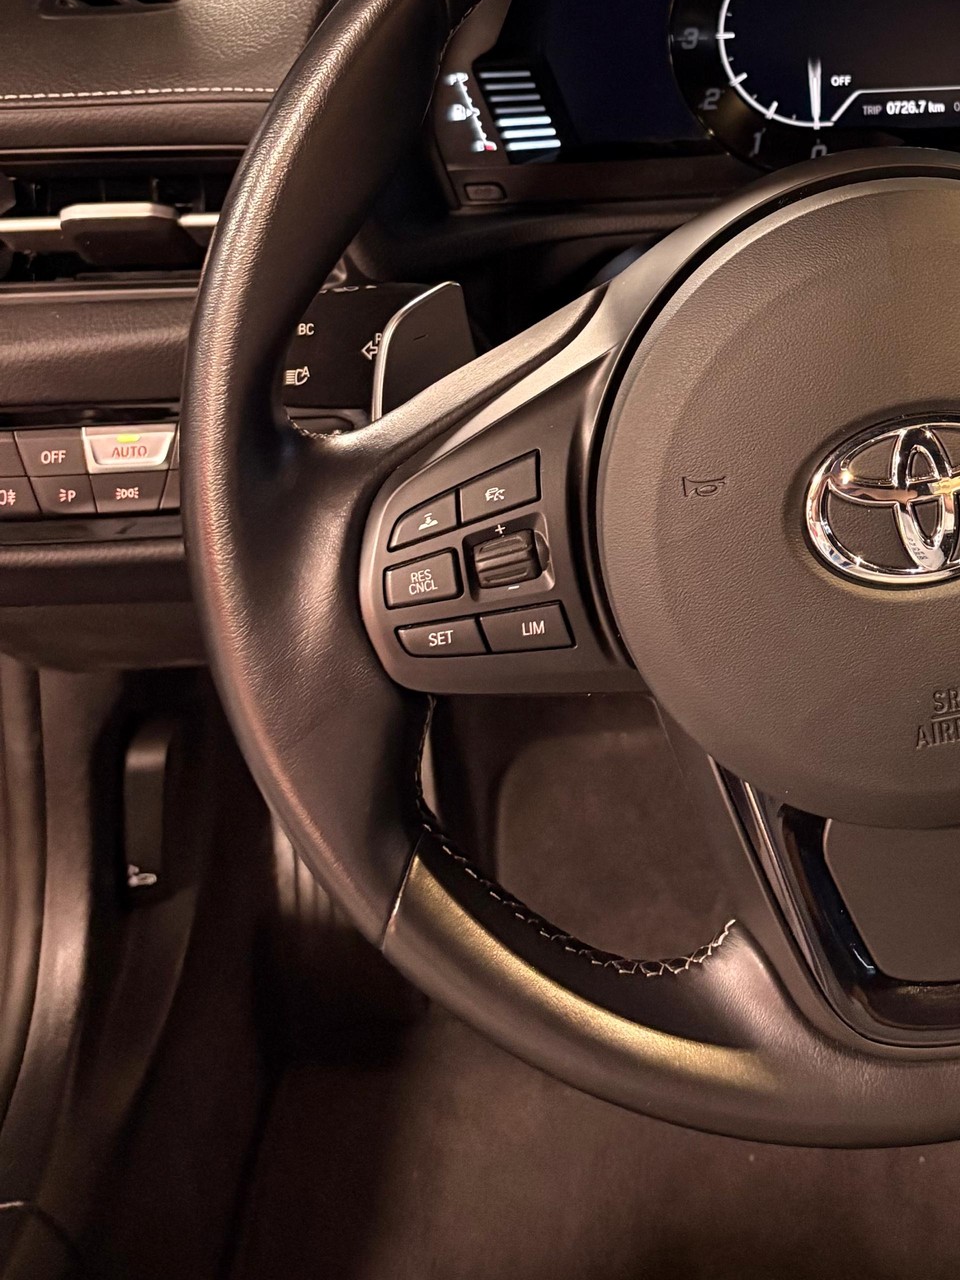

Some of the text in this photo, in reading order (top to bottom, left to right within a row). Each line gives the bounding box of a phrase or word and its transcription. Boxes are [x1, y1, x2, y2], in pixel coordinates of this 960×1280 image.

[681, 28, 699, 50] 3
[830, 75, 852, 87] OFF
[702, 88, 721, 110] 2
[863, 105, 882, 116] TRIP
[886, 100, 926, 116] 0726.7
[928, 101, 946, 113] km
[298, 323, 315, 336] BC
[41, 449, 67, 465] OFF
[112, 445, 148, 458] AUTO
[410, 569, 432, 583] RES
[408, 581, 438, 596] CNCL
[522, 620, 546, 636] LIM
[428, 630, 454, 647] SET
